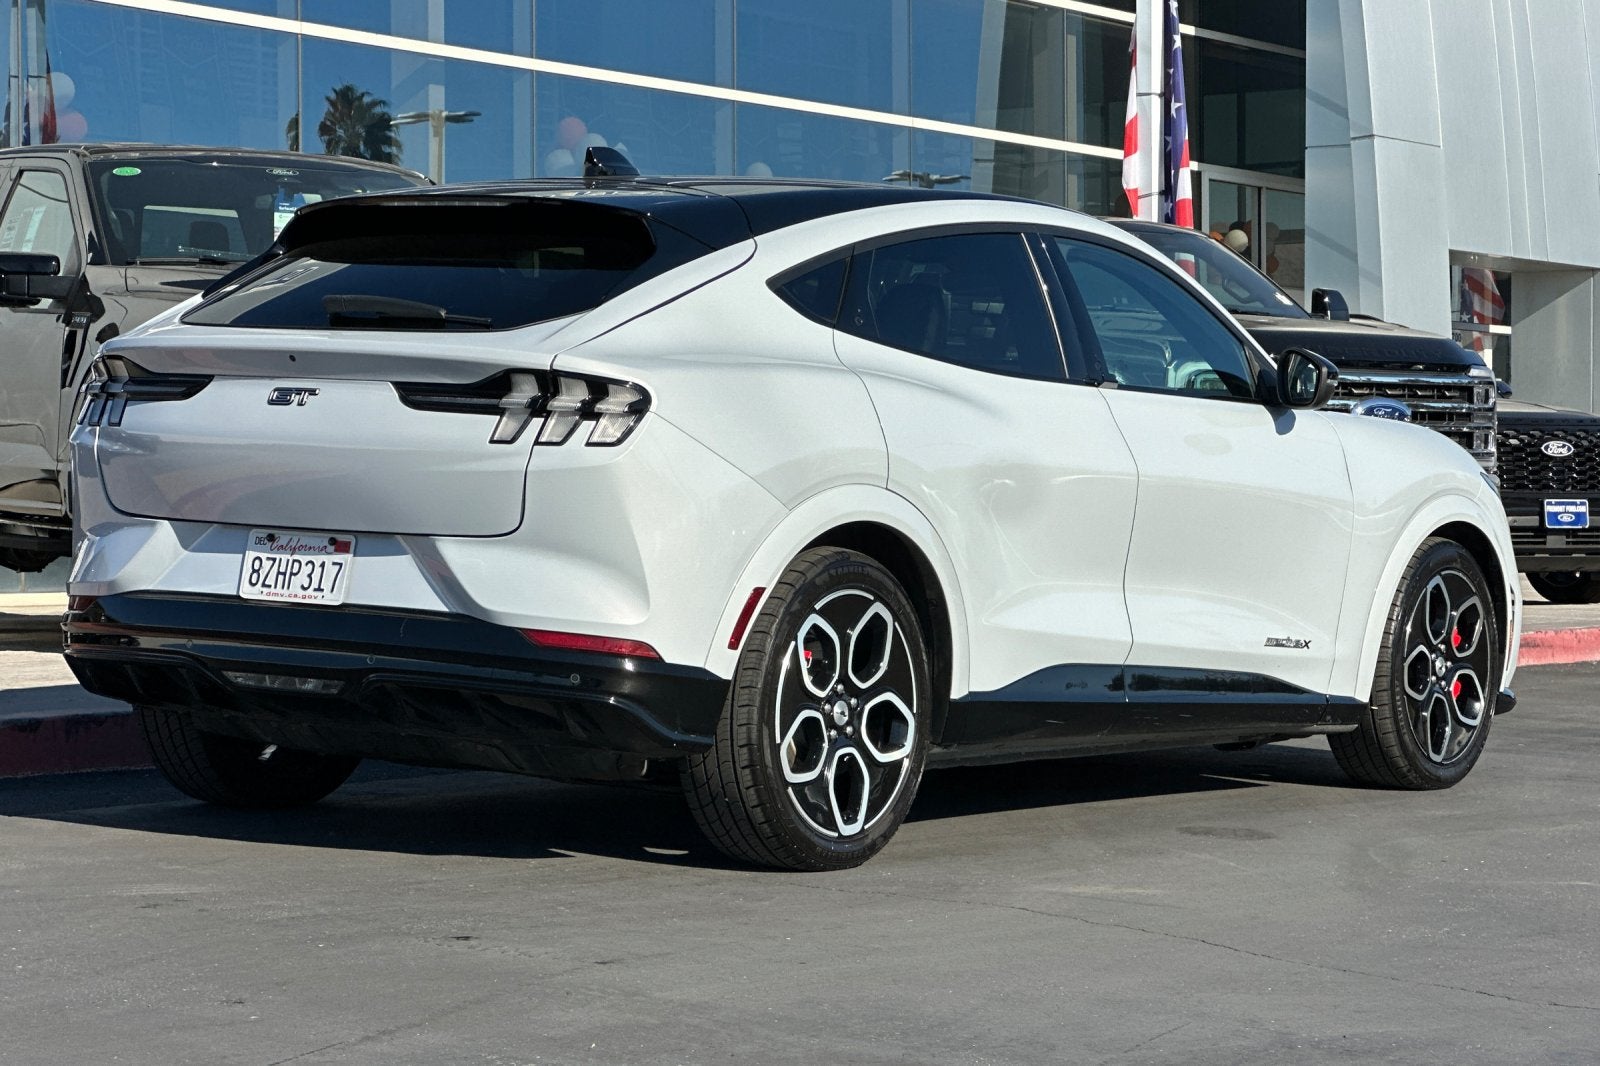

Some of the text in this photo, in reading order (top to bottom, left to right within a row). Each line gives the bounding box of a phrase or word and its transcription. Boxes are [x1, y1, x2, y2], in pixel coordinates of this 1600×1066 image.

[267, 387, 320, 406] GT
[1547, 442, 1569, 454] Ford
[254, 536, 267, 546] DEC
[269, 536, 334, 557] California
[247, 556, 344, 594] 8ZHP317
[265, 591, 319, 600] dmv.ca.gov
